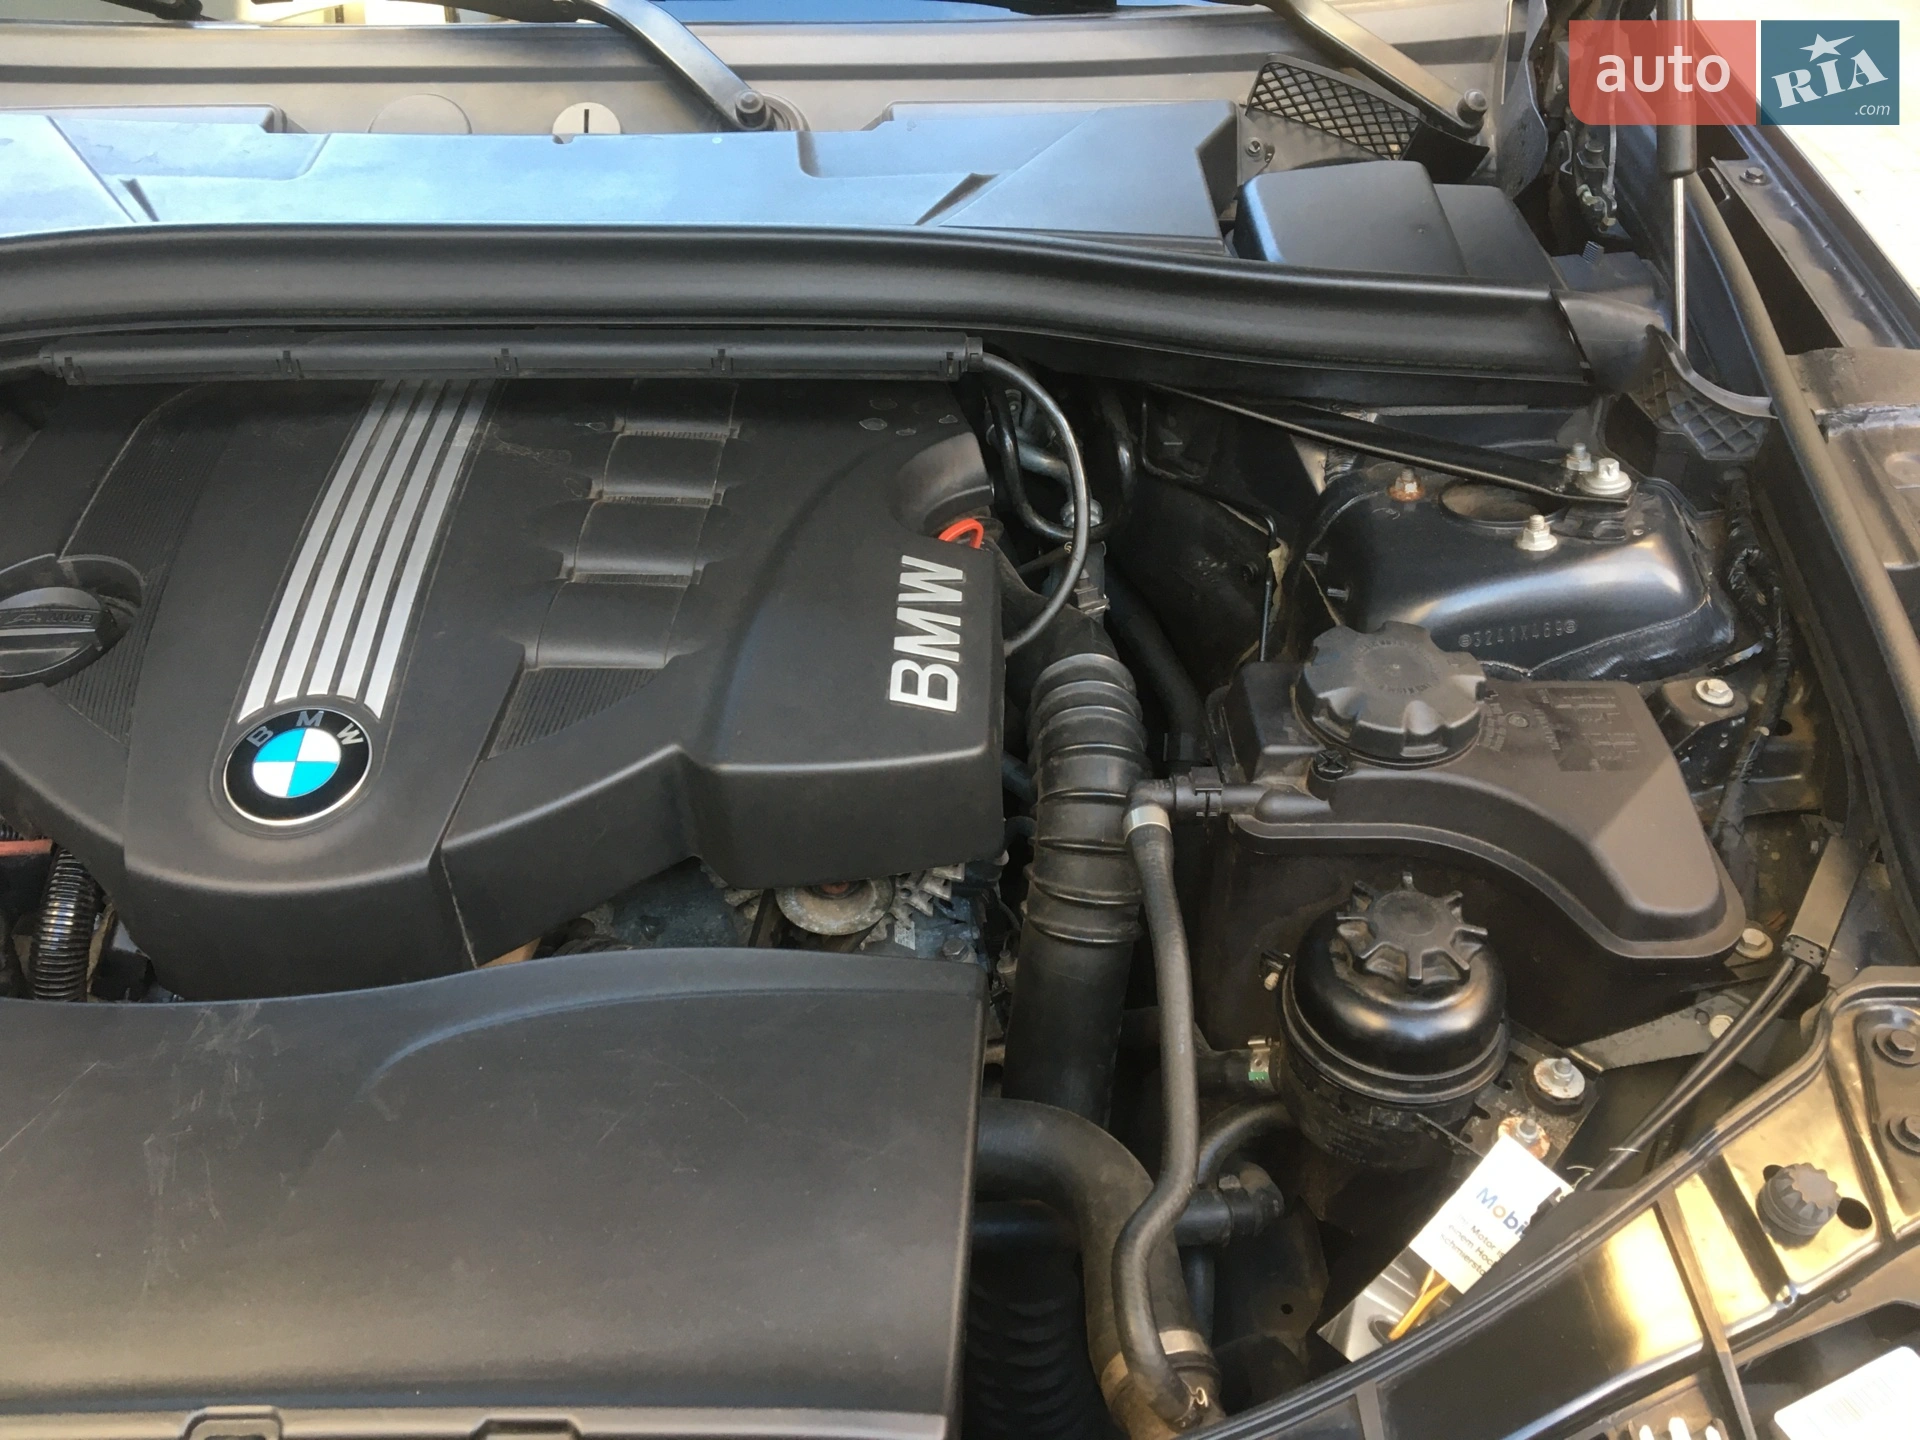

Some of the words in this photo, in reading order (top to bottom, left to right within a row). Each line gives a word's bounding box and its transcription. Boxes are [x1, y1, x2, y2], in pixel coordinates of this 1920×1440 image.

[889, 555, 964, 712] BMW
[246, 710, 364, 748] BMW
[1476, 1187, 1529, 1240] Mobi
[1449, 1225, 1475, 1249] einem
[1475, 1246, 1497, 1267] Hoc
[1471, 1225, 1496, 1250] Motor
